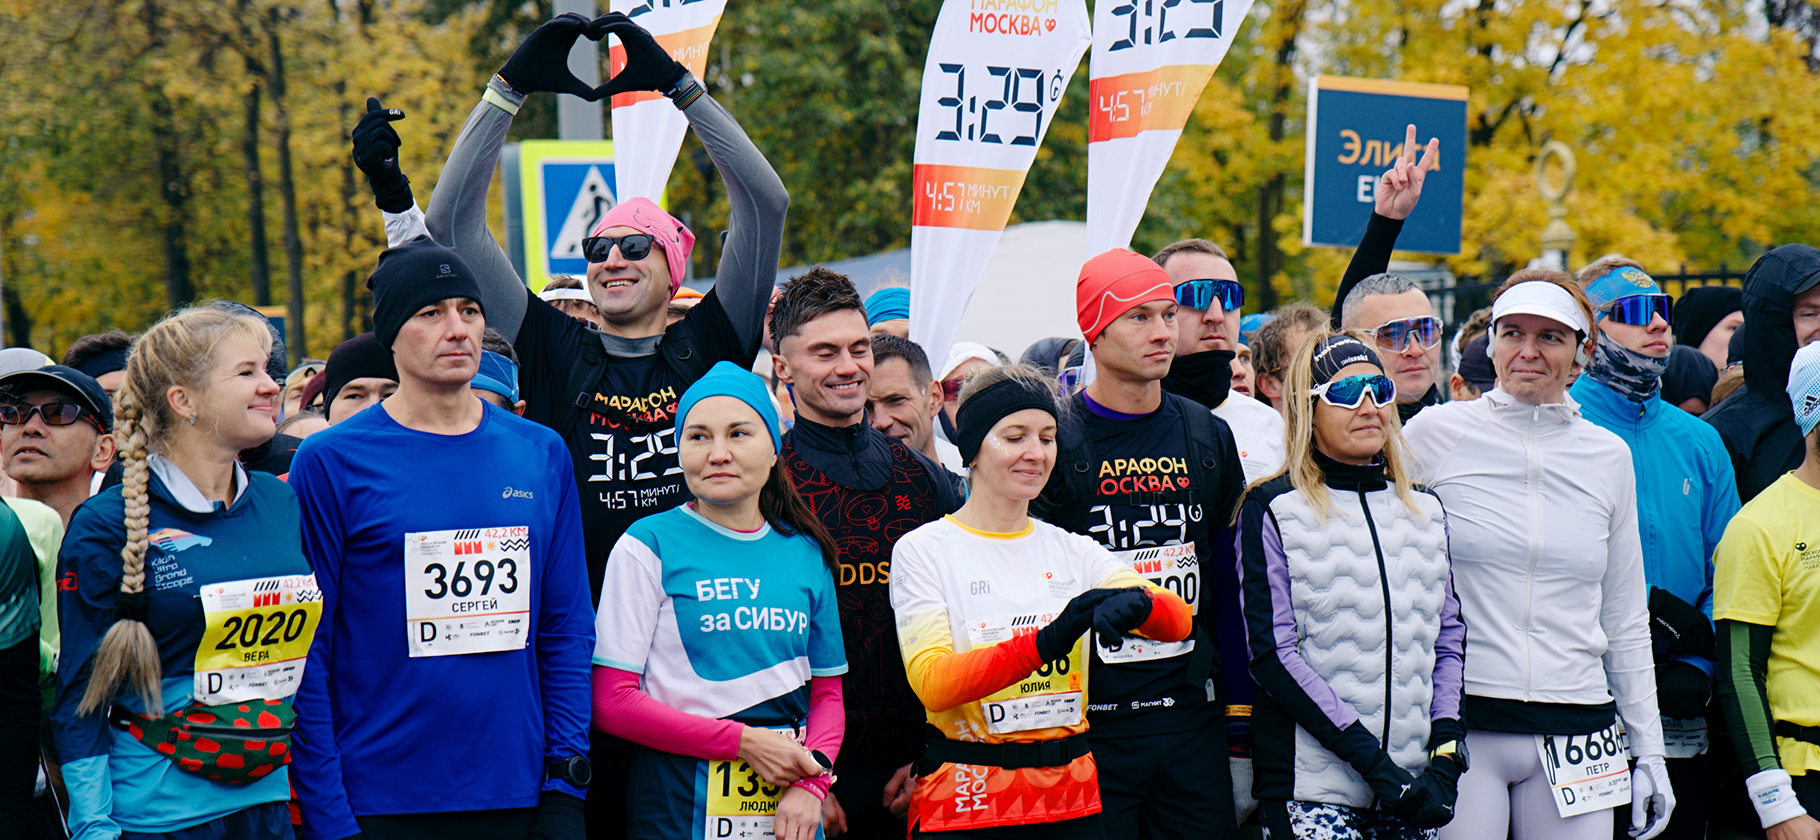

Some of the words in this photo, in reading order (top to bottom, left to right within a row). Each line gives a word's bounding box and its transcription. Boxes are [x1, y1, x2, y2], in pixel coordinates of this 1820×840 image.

[970, 12, 1041, 36] МОСКВА
[935, 63, 1044, 146] 3:29
[926, 181, 965, 211] 4:57
[965, 200, 980, 214] КМ
[588, 427, 684, 482] 3:29
[1098, 457, 1188, 478] АРАФОН
[513, 489, 534, 499] asics
[1097, 475, 1177, 495] ОСКВА
[599, 490, 639, 509] 4:57
[640, 484, 680, 498] МИНУТ/
[641, 497, 658, 507] КМ
[484, 528, 508, 539] 42,2
[1163, 547, 1184, 559] 42,2
[155, 568, 187, 583] Grand
[423, 558, 518, 599] 3693
[696, 578, 760, 601] БЕГУ
[970, 580, 990, 595] GRi
[452, 597, 498, 613] СЕРГЕЙ
[215, 609, 307, 651] 2020
[700, 612, 731, 632] за
[420, 622, 437, 643] D
[244, 650, 270, 662] ВЕРА
[208, 672, 223, 694] D
[1020, 681, 1051, 693] ЮЛИЯ
[989, 704, 1005, 723] D
[1086, 703, 1118, 711] FONBET
[1140, 700, 1162, 708] МАГНИТ
[1661, 718, 1683, 728] СЛАВ
[1586, 762, 1610, 776] ПЕТР
[1561, 787, 1576, 806] D
[717, 818, 732, 838] D
